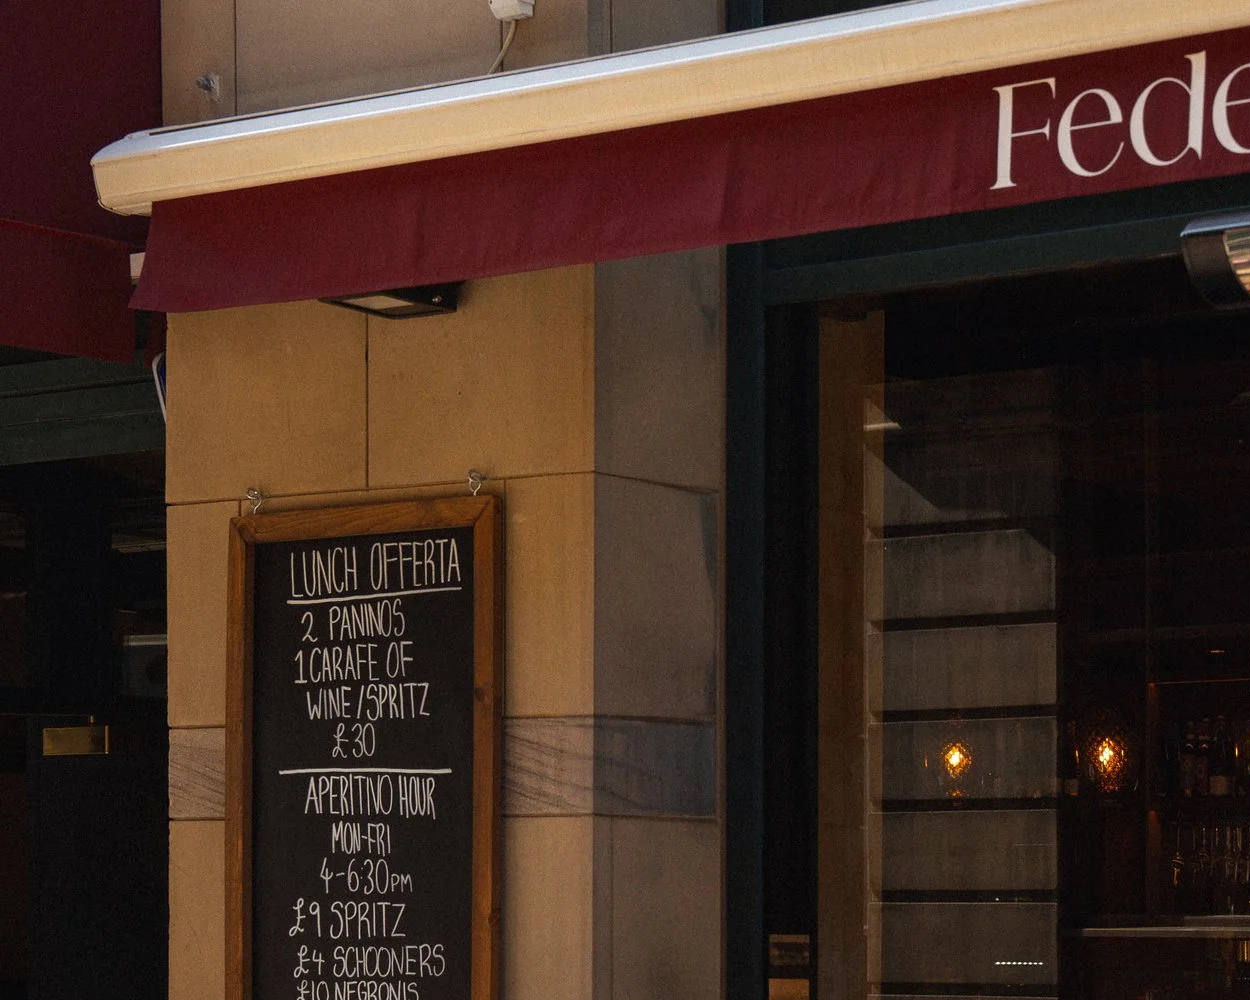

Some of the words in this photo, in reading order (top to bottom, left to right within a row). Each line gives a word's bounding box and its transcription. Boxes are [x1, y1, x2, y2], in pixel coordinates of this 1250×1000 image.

[290, 546, 359, 598] LUNCH
[370, 538, 462, 591] OFFERTA
[300, 611, 319, 643] 2
[328, 598, 406, 641] PANINOS
[294, 650, 308, 684] 1
[309, 643, 379, 683] CARAFE
[386, 641, 414, 679] OF
[306, 685, 352, 721] WINE
[331, 722, 376, 759] £30
[398, 775, 436, 820] HOUR
[331, 820, 391, 857] MON-FRI
[288, 897, 322, 938] £9
[330, 900, 406, 940] SPRITZ
[293, 944, 326, 979] £4
[333, 943, 446, 978] SCHOONERS
